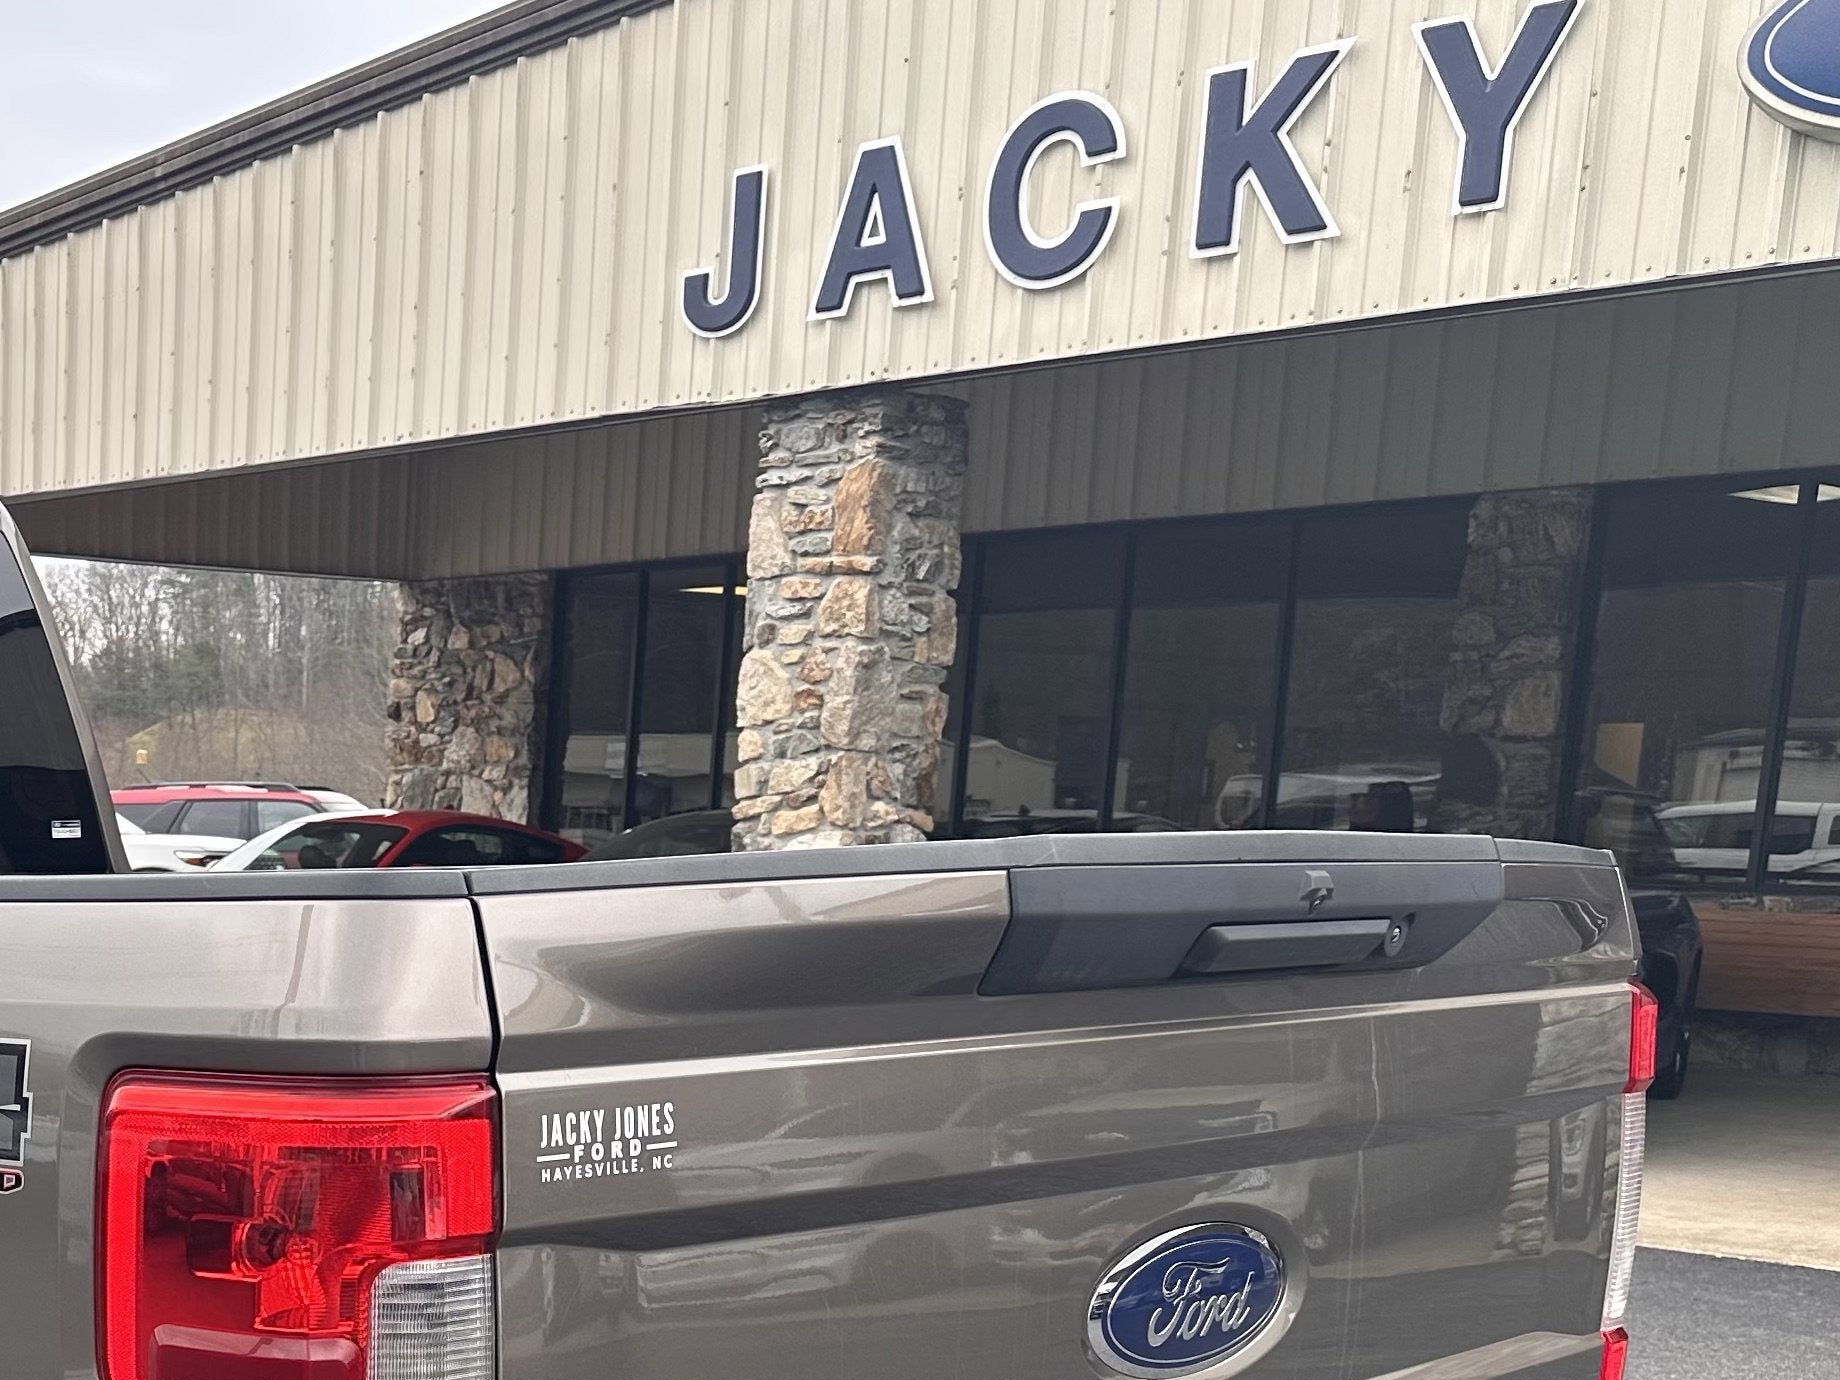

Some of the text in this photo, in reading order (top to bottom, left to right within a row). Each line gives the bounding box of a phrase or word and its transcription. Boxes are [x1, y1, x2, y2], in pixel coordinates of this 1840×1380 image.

[681, 0, 1582, 338] JACKY
[539, 1102, 675, 1149] JACKY JONES
[573, 1138, 643, 1164] FORD
[652, 1154, 673, 1170] NC
[1147, 1255, 1258, 1348] Ford
